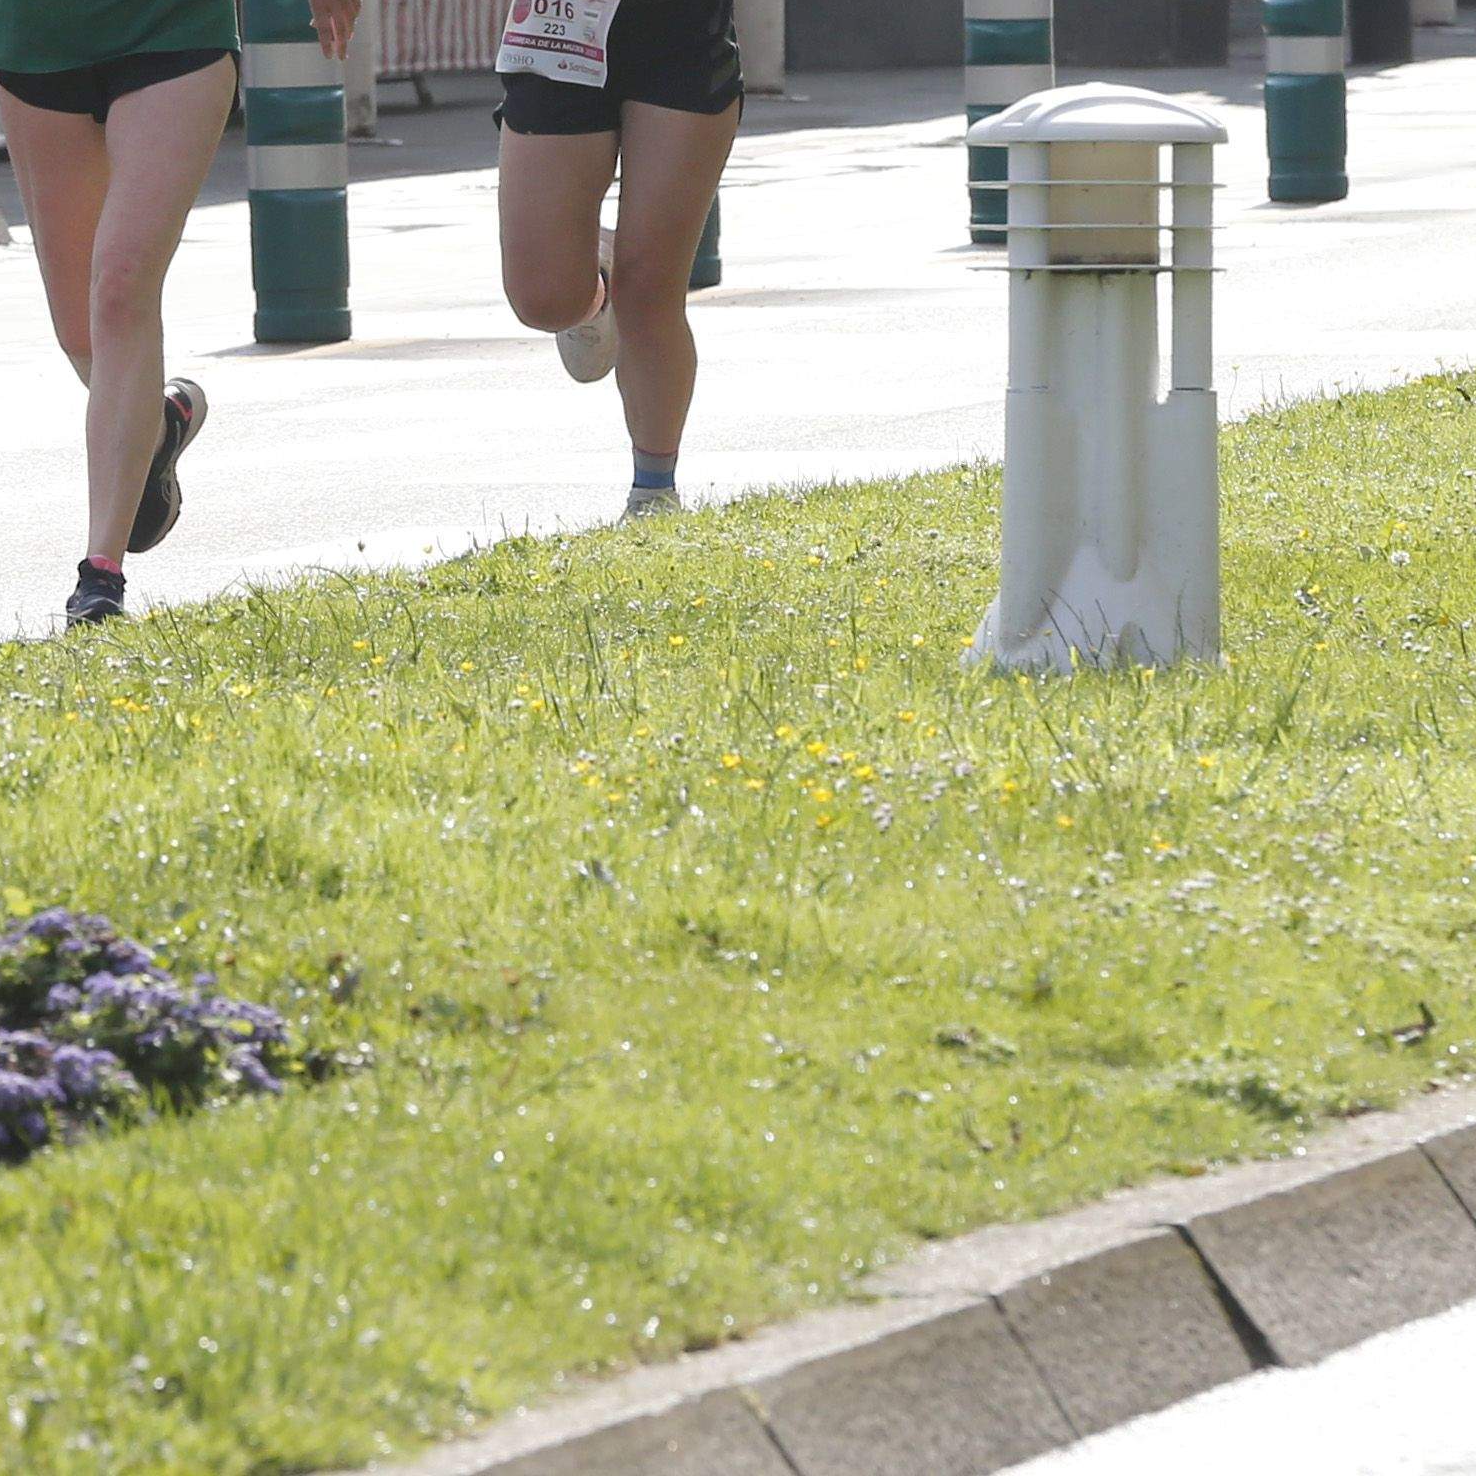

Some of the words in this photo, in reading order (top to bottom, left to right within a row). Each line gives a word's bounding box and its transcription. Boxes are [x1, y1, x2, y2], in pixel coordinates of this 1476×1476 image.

[544, 22, 566, 36] 223
[538, 40, 549, 48] DE
[550, 42, 561, 50] LA
